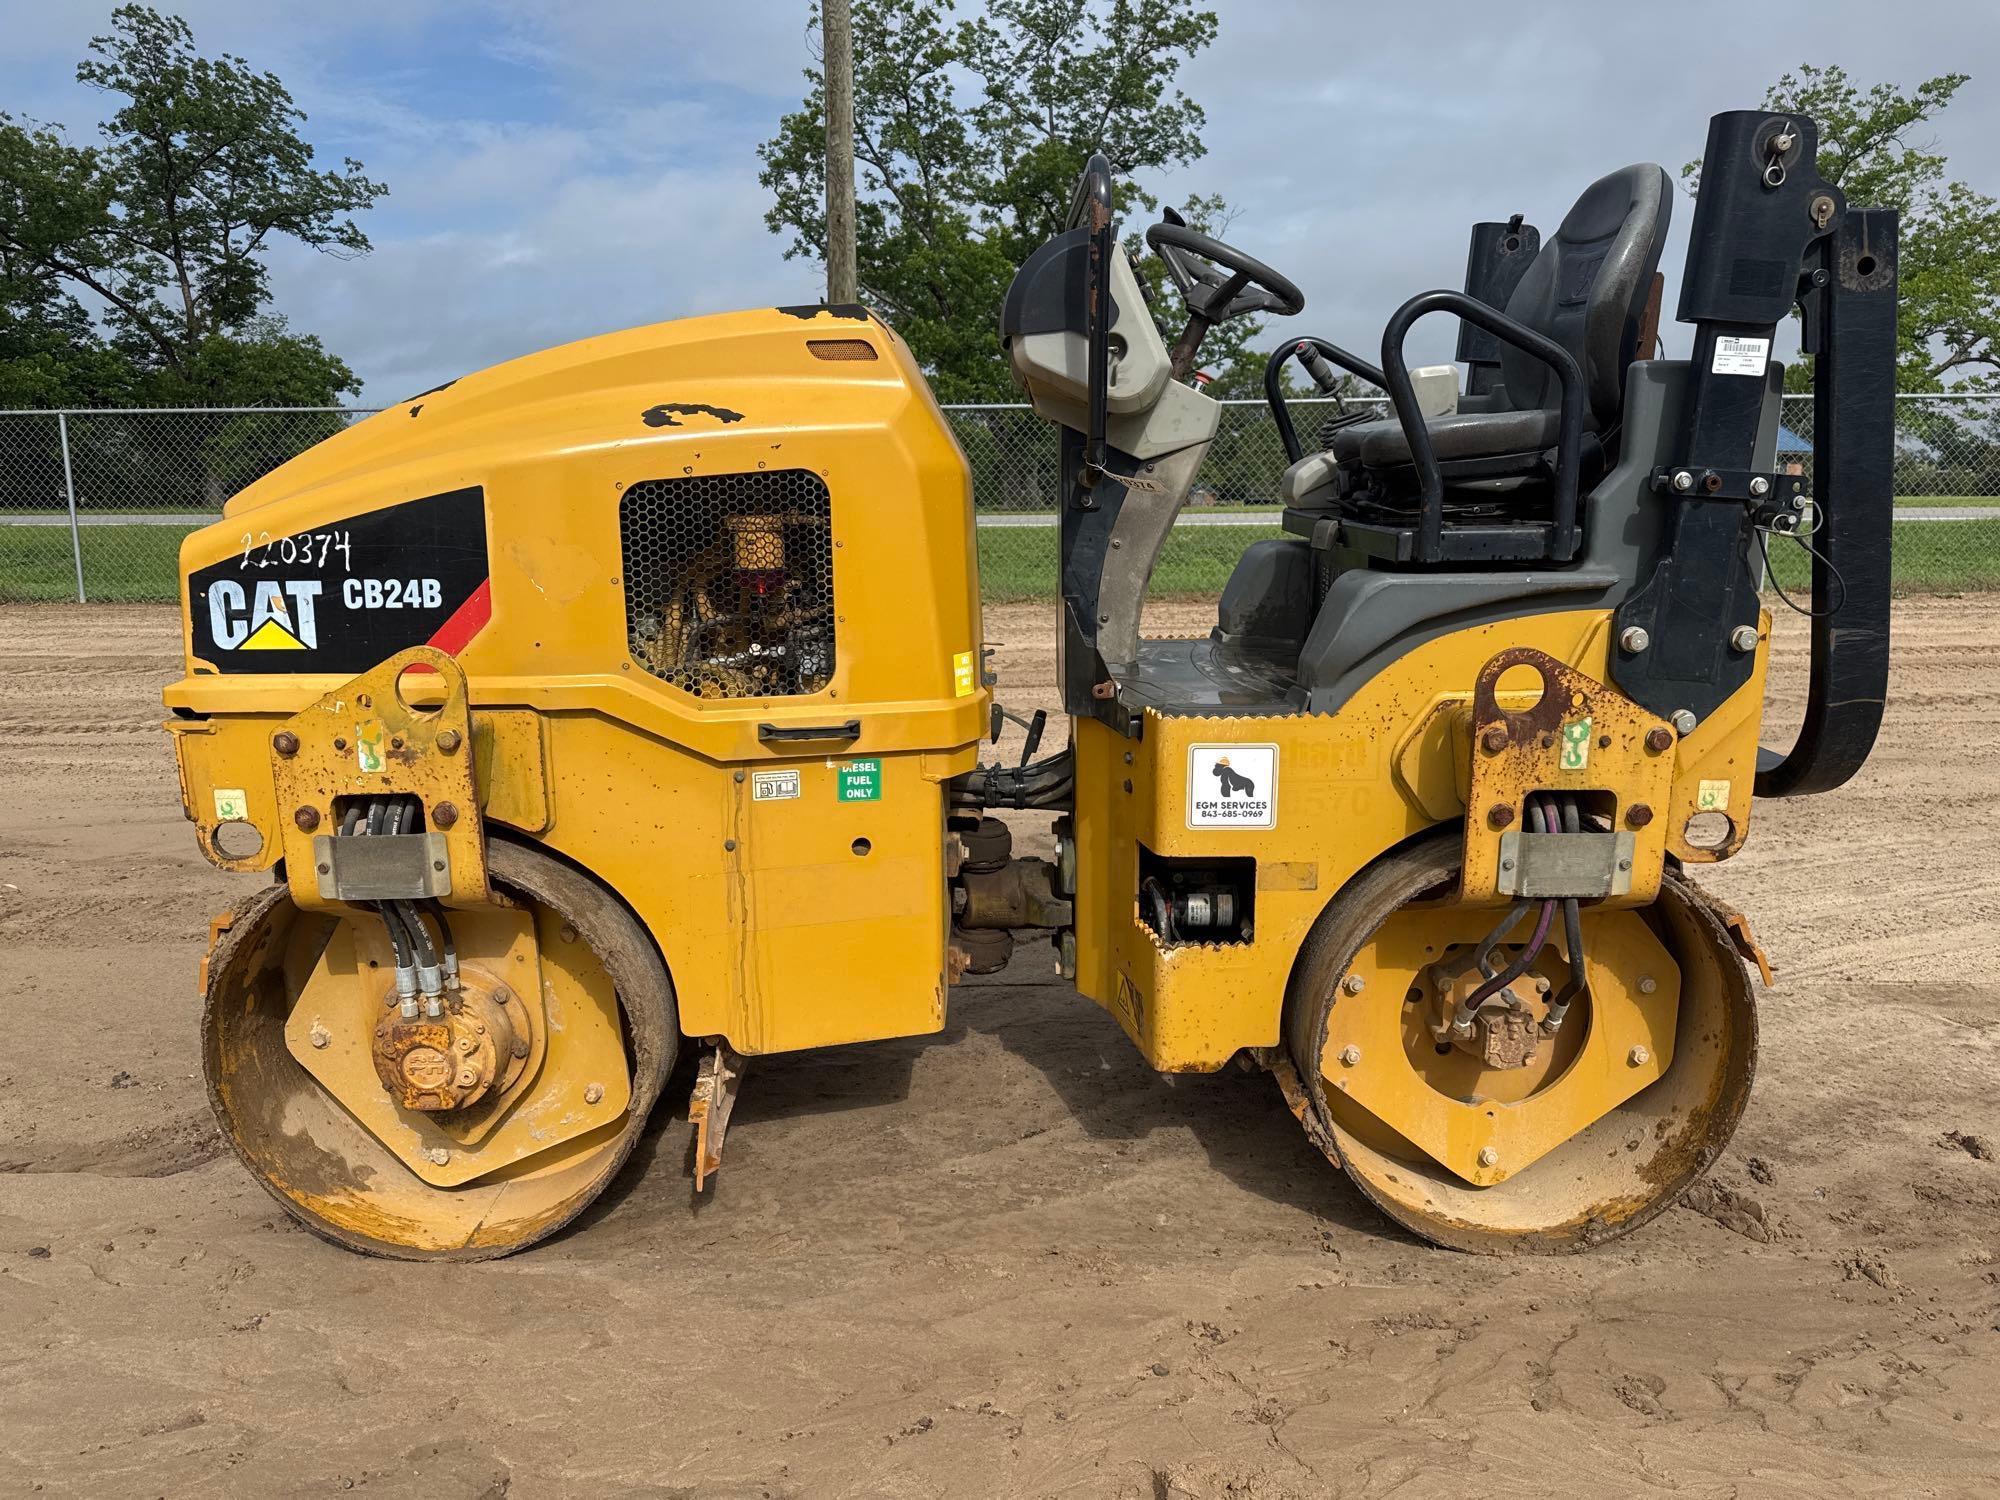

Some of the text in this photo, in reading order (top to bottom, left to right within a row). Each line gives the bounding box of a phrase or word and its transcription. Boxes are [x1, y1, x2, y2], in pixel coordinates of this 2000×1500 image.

[240, 531, 351, 572] 220374
[343, 578, 442, 609] CB24B
[208, 580, 323, 650] CAT
[847, 776, 873, 786] FUEL
[846, 789, 873, 798] ONLY
[1196, 801, 1267, 810] EGM SERVICES
[1201, 810, 1264, 818] 843-685-0969
